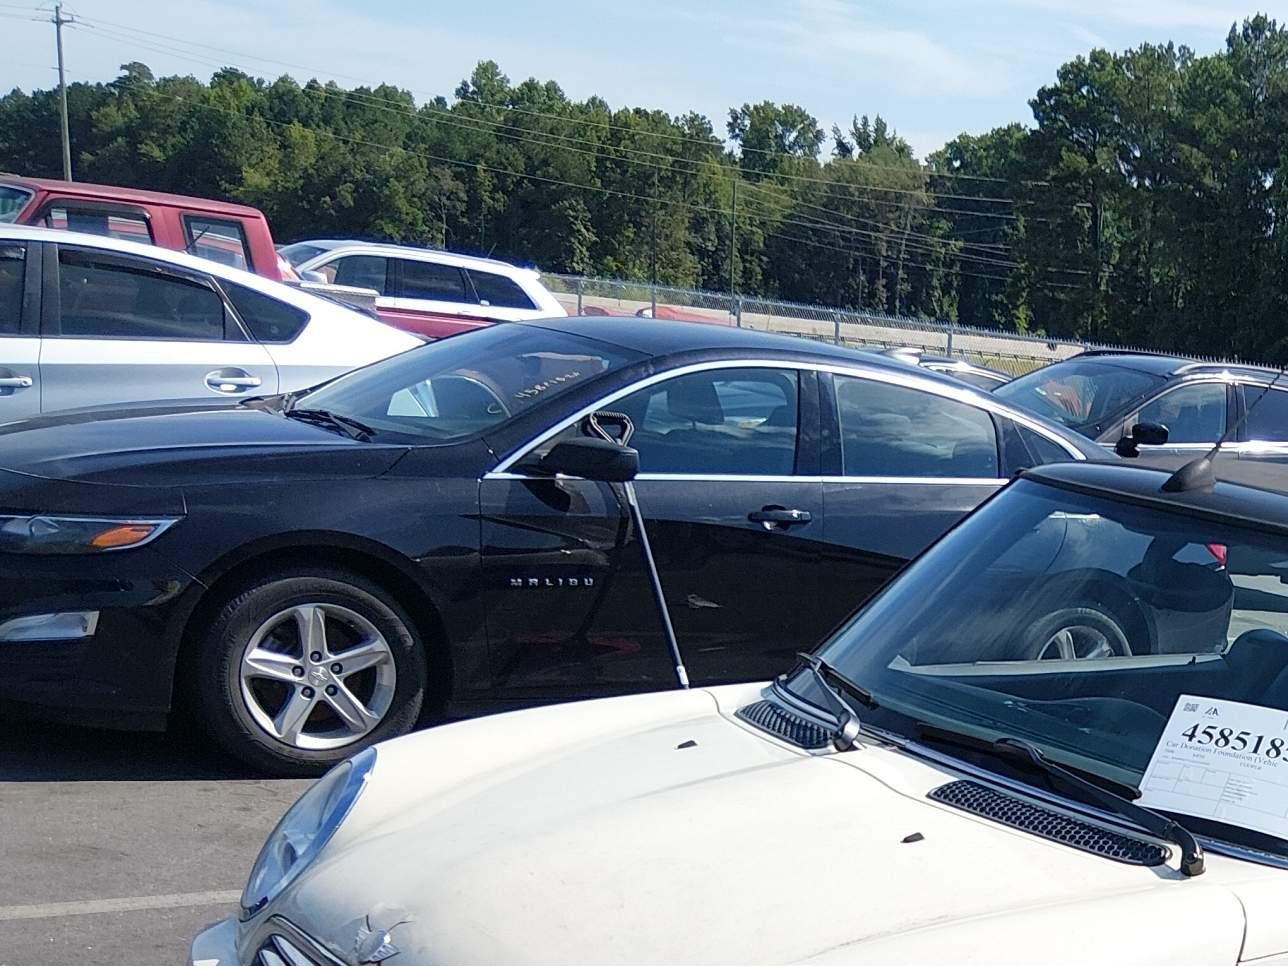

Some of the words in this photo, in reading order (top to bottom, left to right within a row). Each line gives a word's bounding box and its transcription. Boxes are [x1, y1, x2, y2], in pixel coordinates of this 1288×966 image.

[510, 577, 594, 586] MALIBU
[1180, 742, 1212, 753] Donation
[1213, 747, 1253, 761] Foundation
